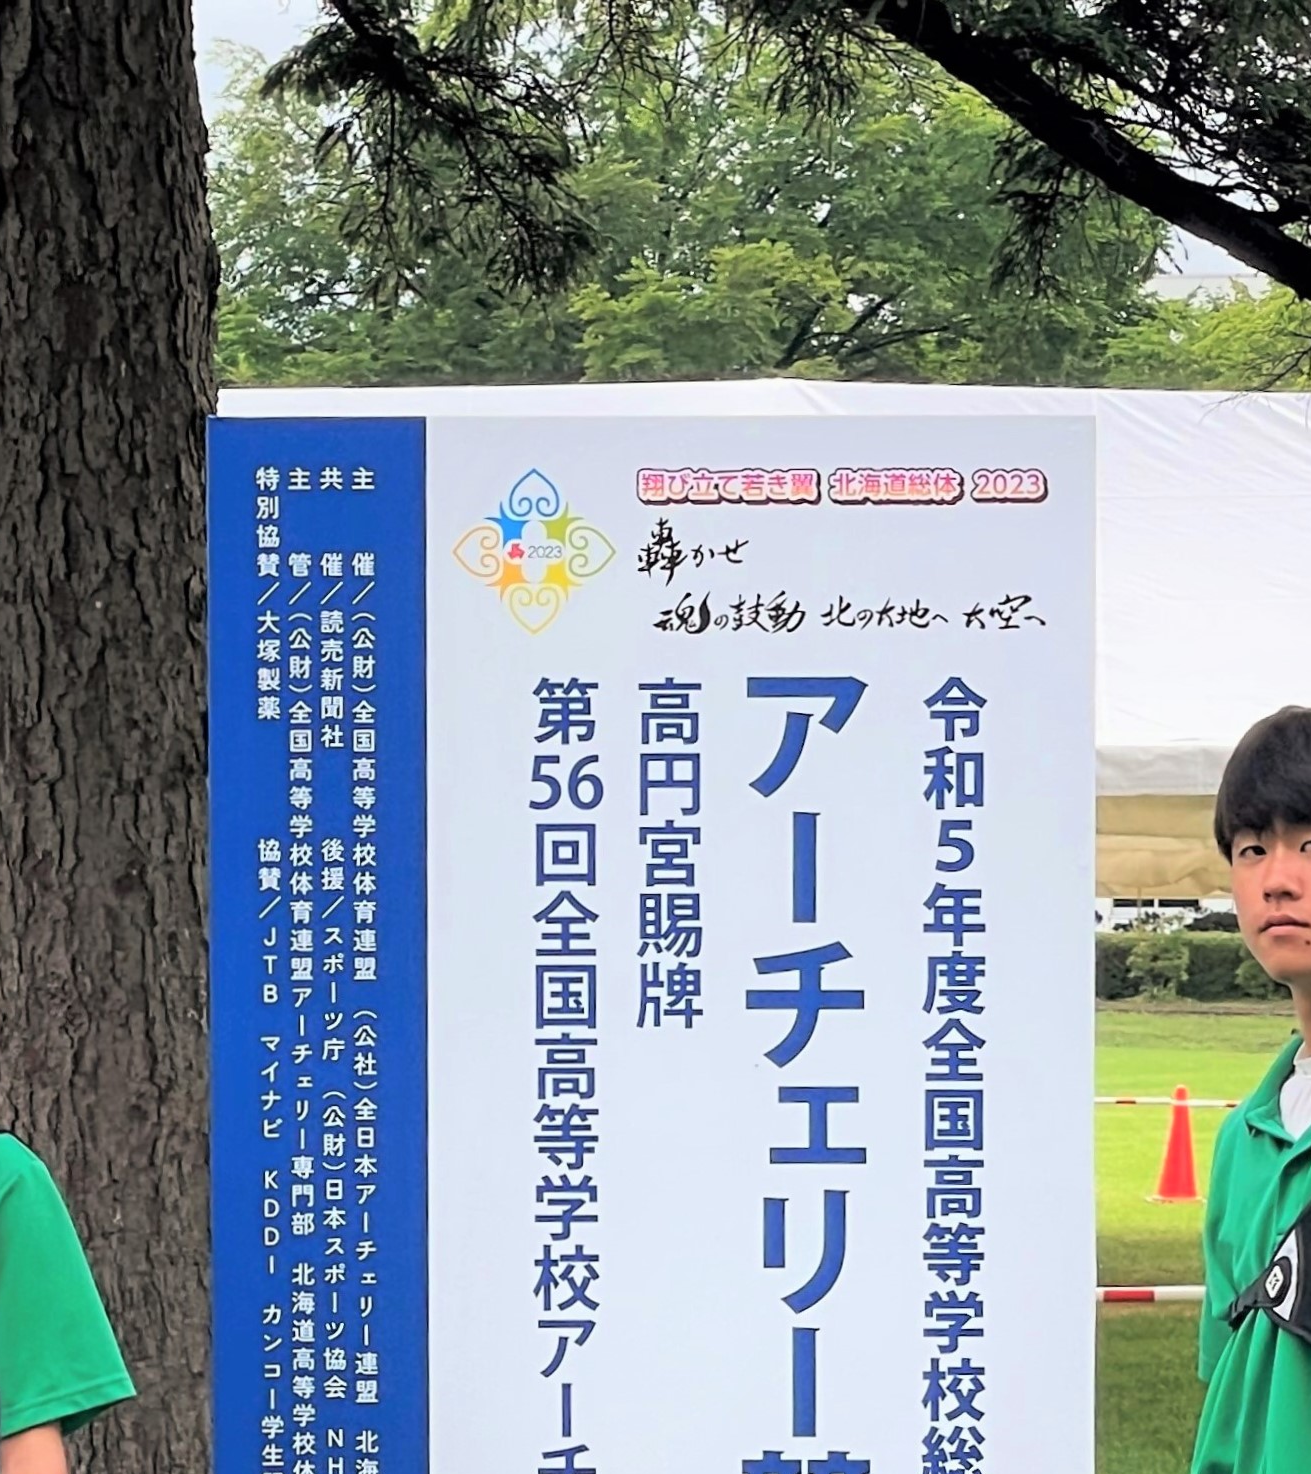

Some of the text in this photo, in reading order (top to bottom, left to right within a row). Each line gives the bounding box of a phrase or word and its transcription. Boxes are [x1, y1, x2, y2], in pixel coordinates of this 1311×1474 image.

[639, 469, 1046, 502] 翔び立て若き翼 北海道総体 2023
[527, 544, 563, 559] 2023
[654, 591, 805, 634] 魂の鼓動
[963, 594, 1046, 630] 大空へ
[637, 677, 703, 1029] 高円宮賜牌
[261, 1037, 282, 1137] マイナビ
[265, 1171, 279, 1273] KDDI
